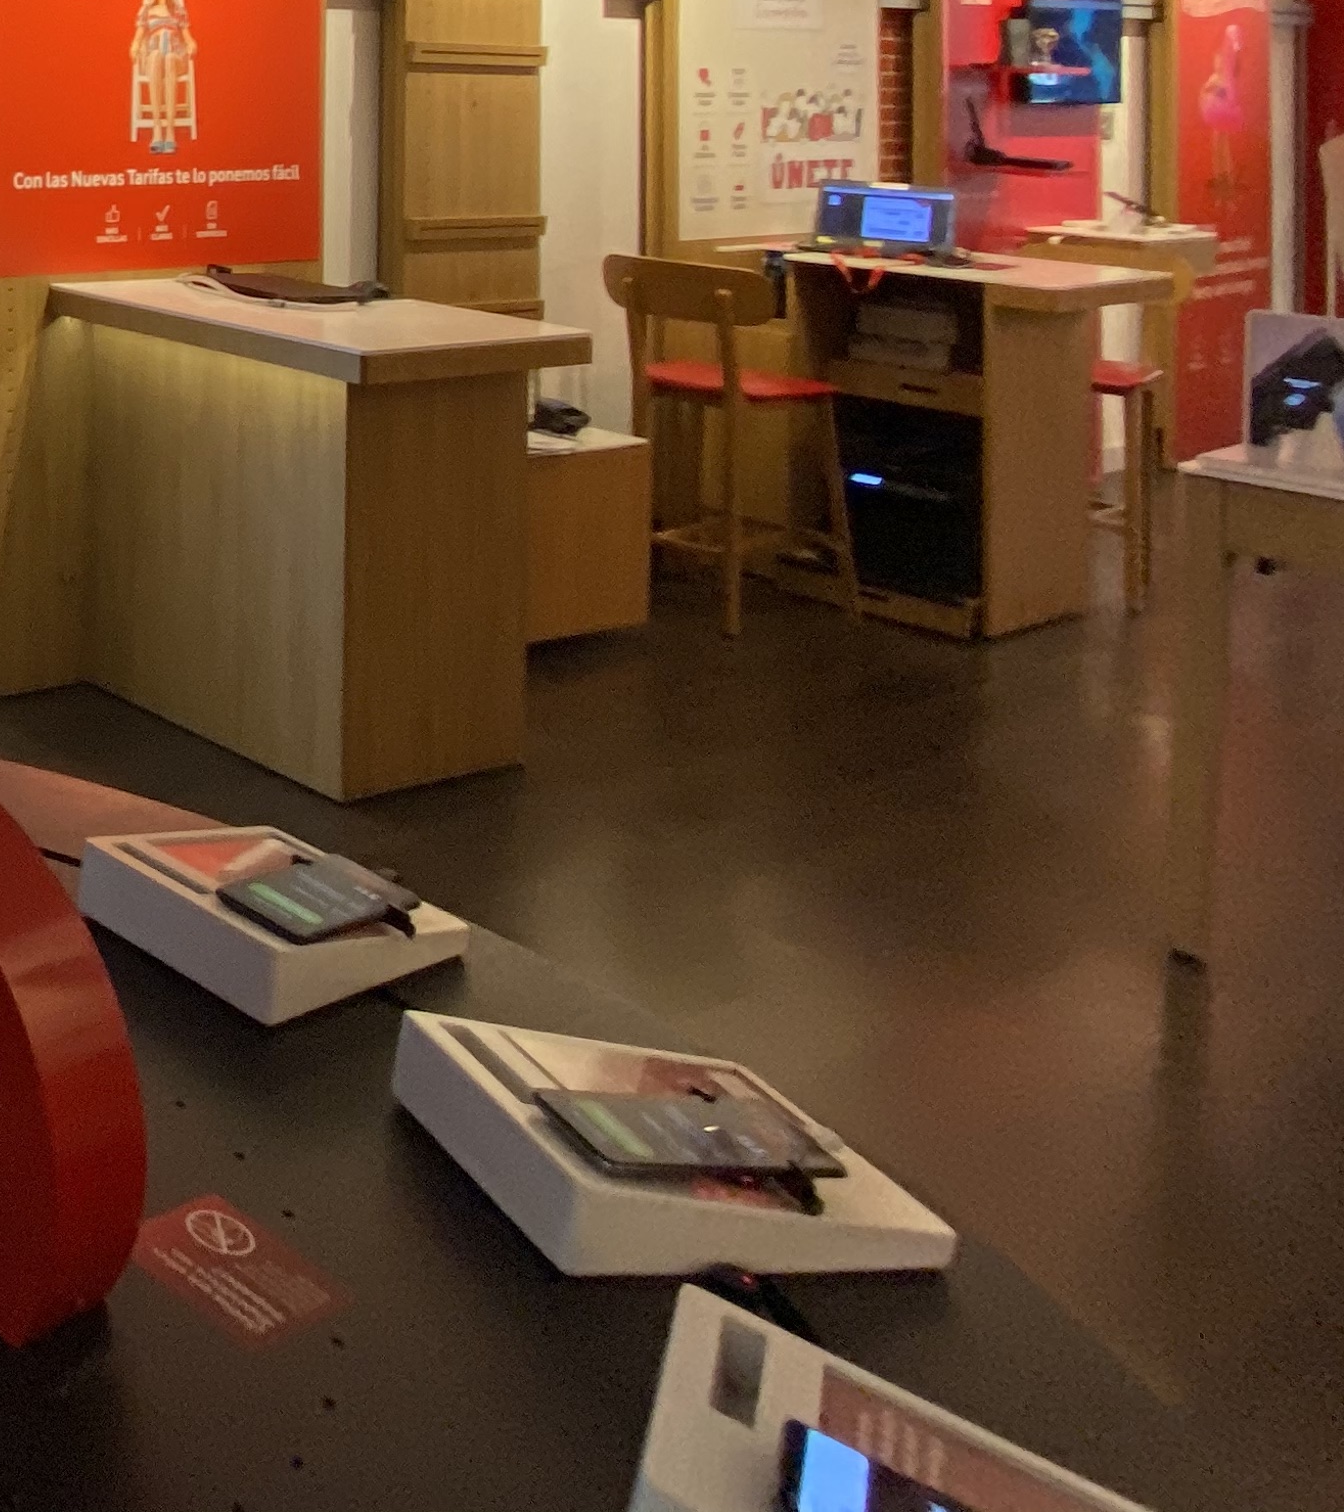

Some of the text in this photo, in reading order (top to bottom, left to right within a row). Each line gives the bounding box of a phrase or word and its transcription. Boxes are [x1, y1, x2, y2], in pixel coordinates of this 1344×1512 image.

[13, 164, 300, 189] Con las Nuevas Tarifas te lo ponemos fácil
